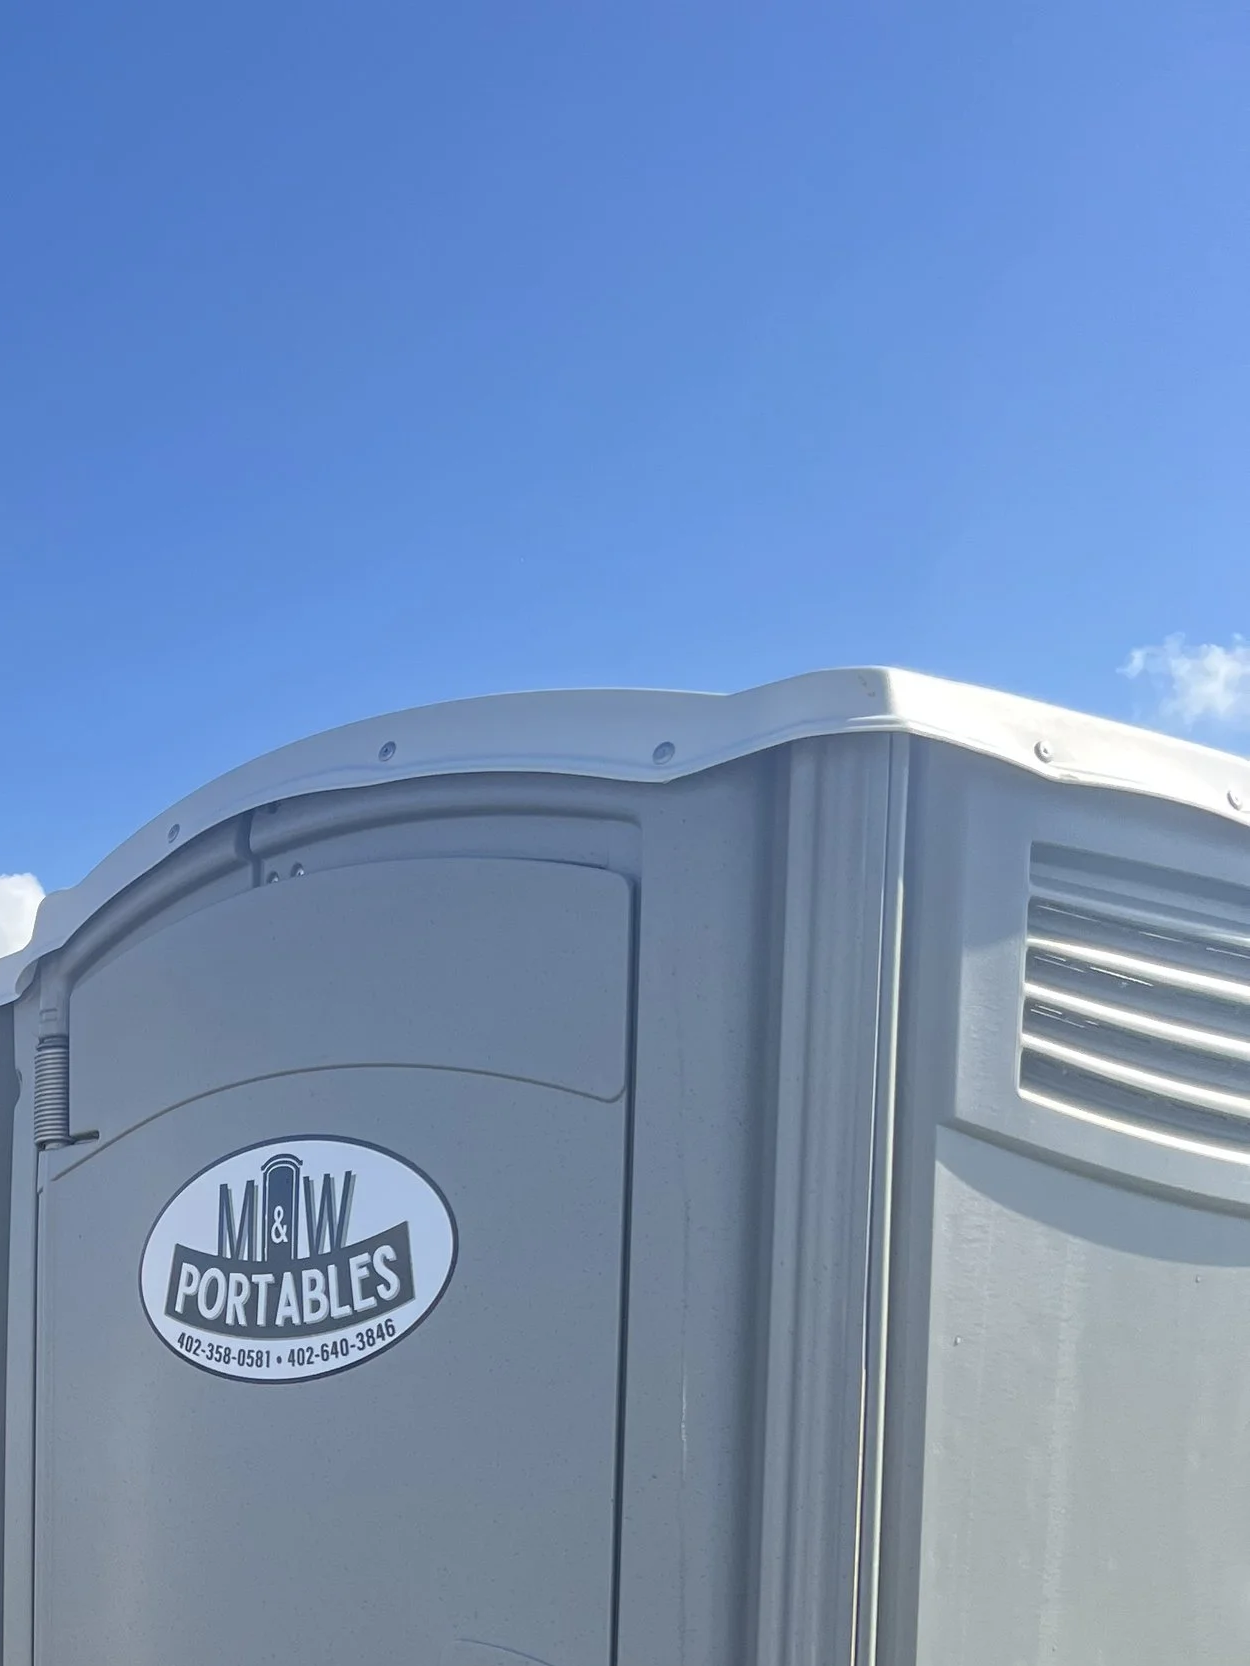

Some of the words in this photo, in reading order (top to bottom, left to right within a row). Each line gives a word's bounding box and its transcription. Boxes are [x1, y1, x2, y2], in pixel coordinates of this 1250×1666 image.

[174, 1244, 401, 1328] PORTABLES
[176, 1331, 271, 1369] 402-358-0581
[287, 1317, 396, 1368] 402-640-3846
